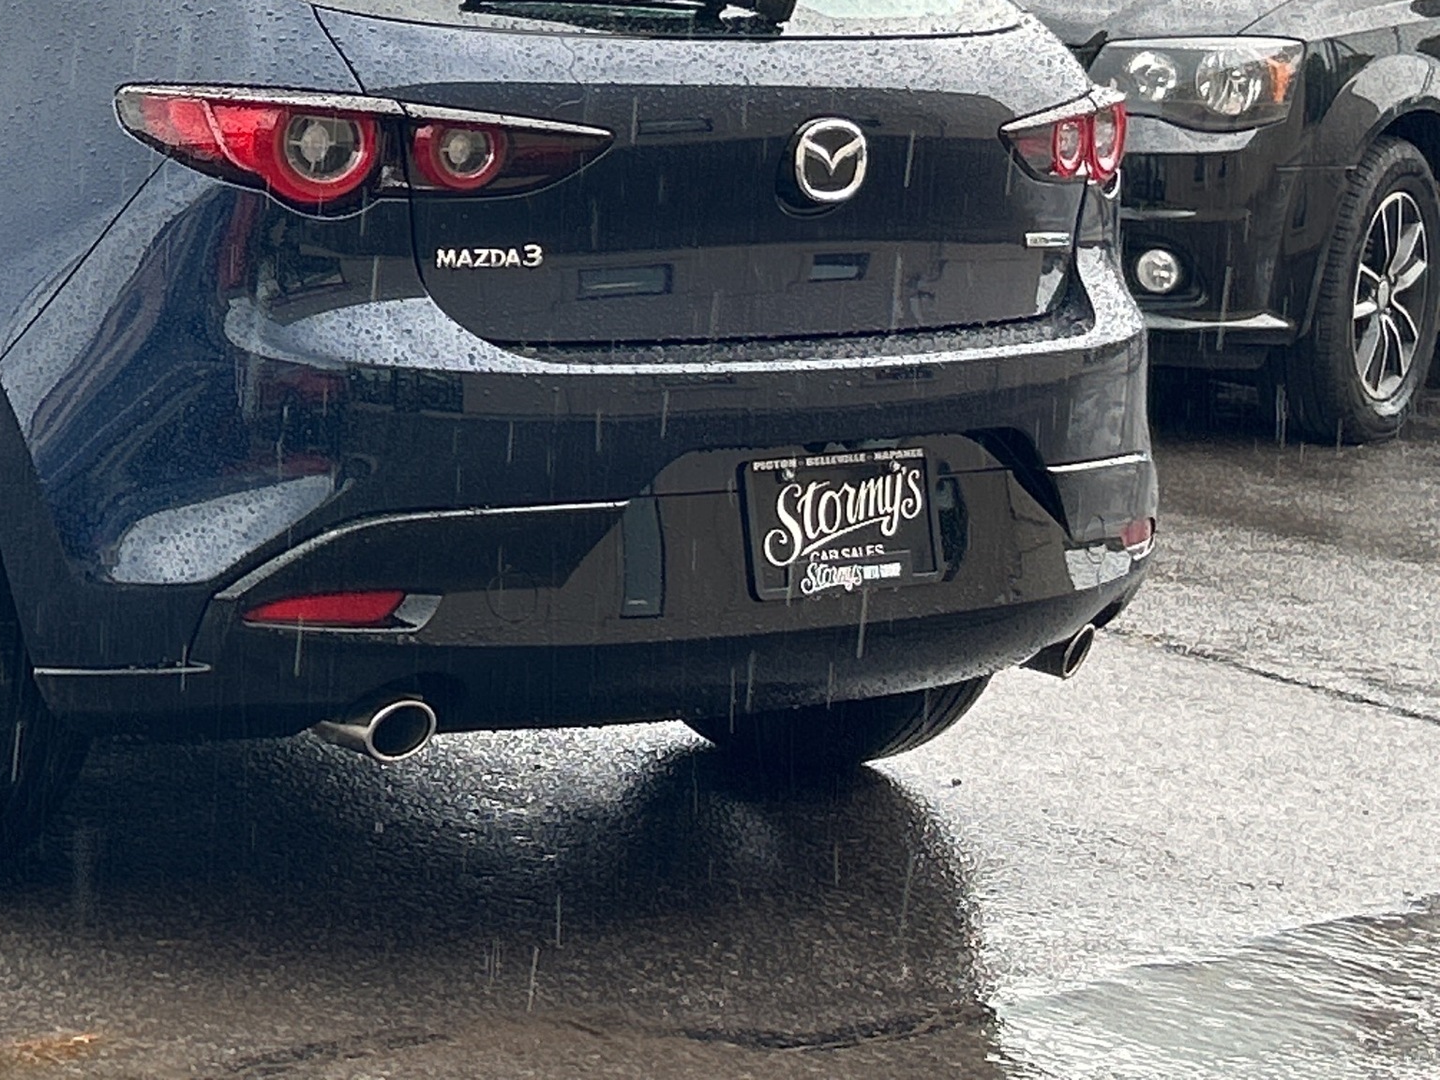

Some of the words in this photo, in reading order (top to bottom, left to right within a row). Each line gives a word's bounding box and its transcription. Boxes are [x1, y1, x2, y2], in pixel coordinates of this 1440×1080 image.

[752, 458, 798, 471] PICTON
[805, 452, 866, 467] BELLEVILLE
[873, 447, 924, 461] NAPANEE
[763, 466, 922, 566] Stormy's
[810, 549, 839, 561] CAR
